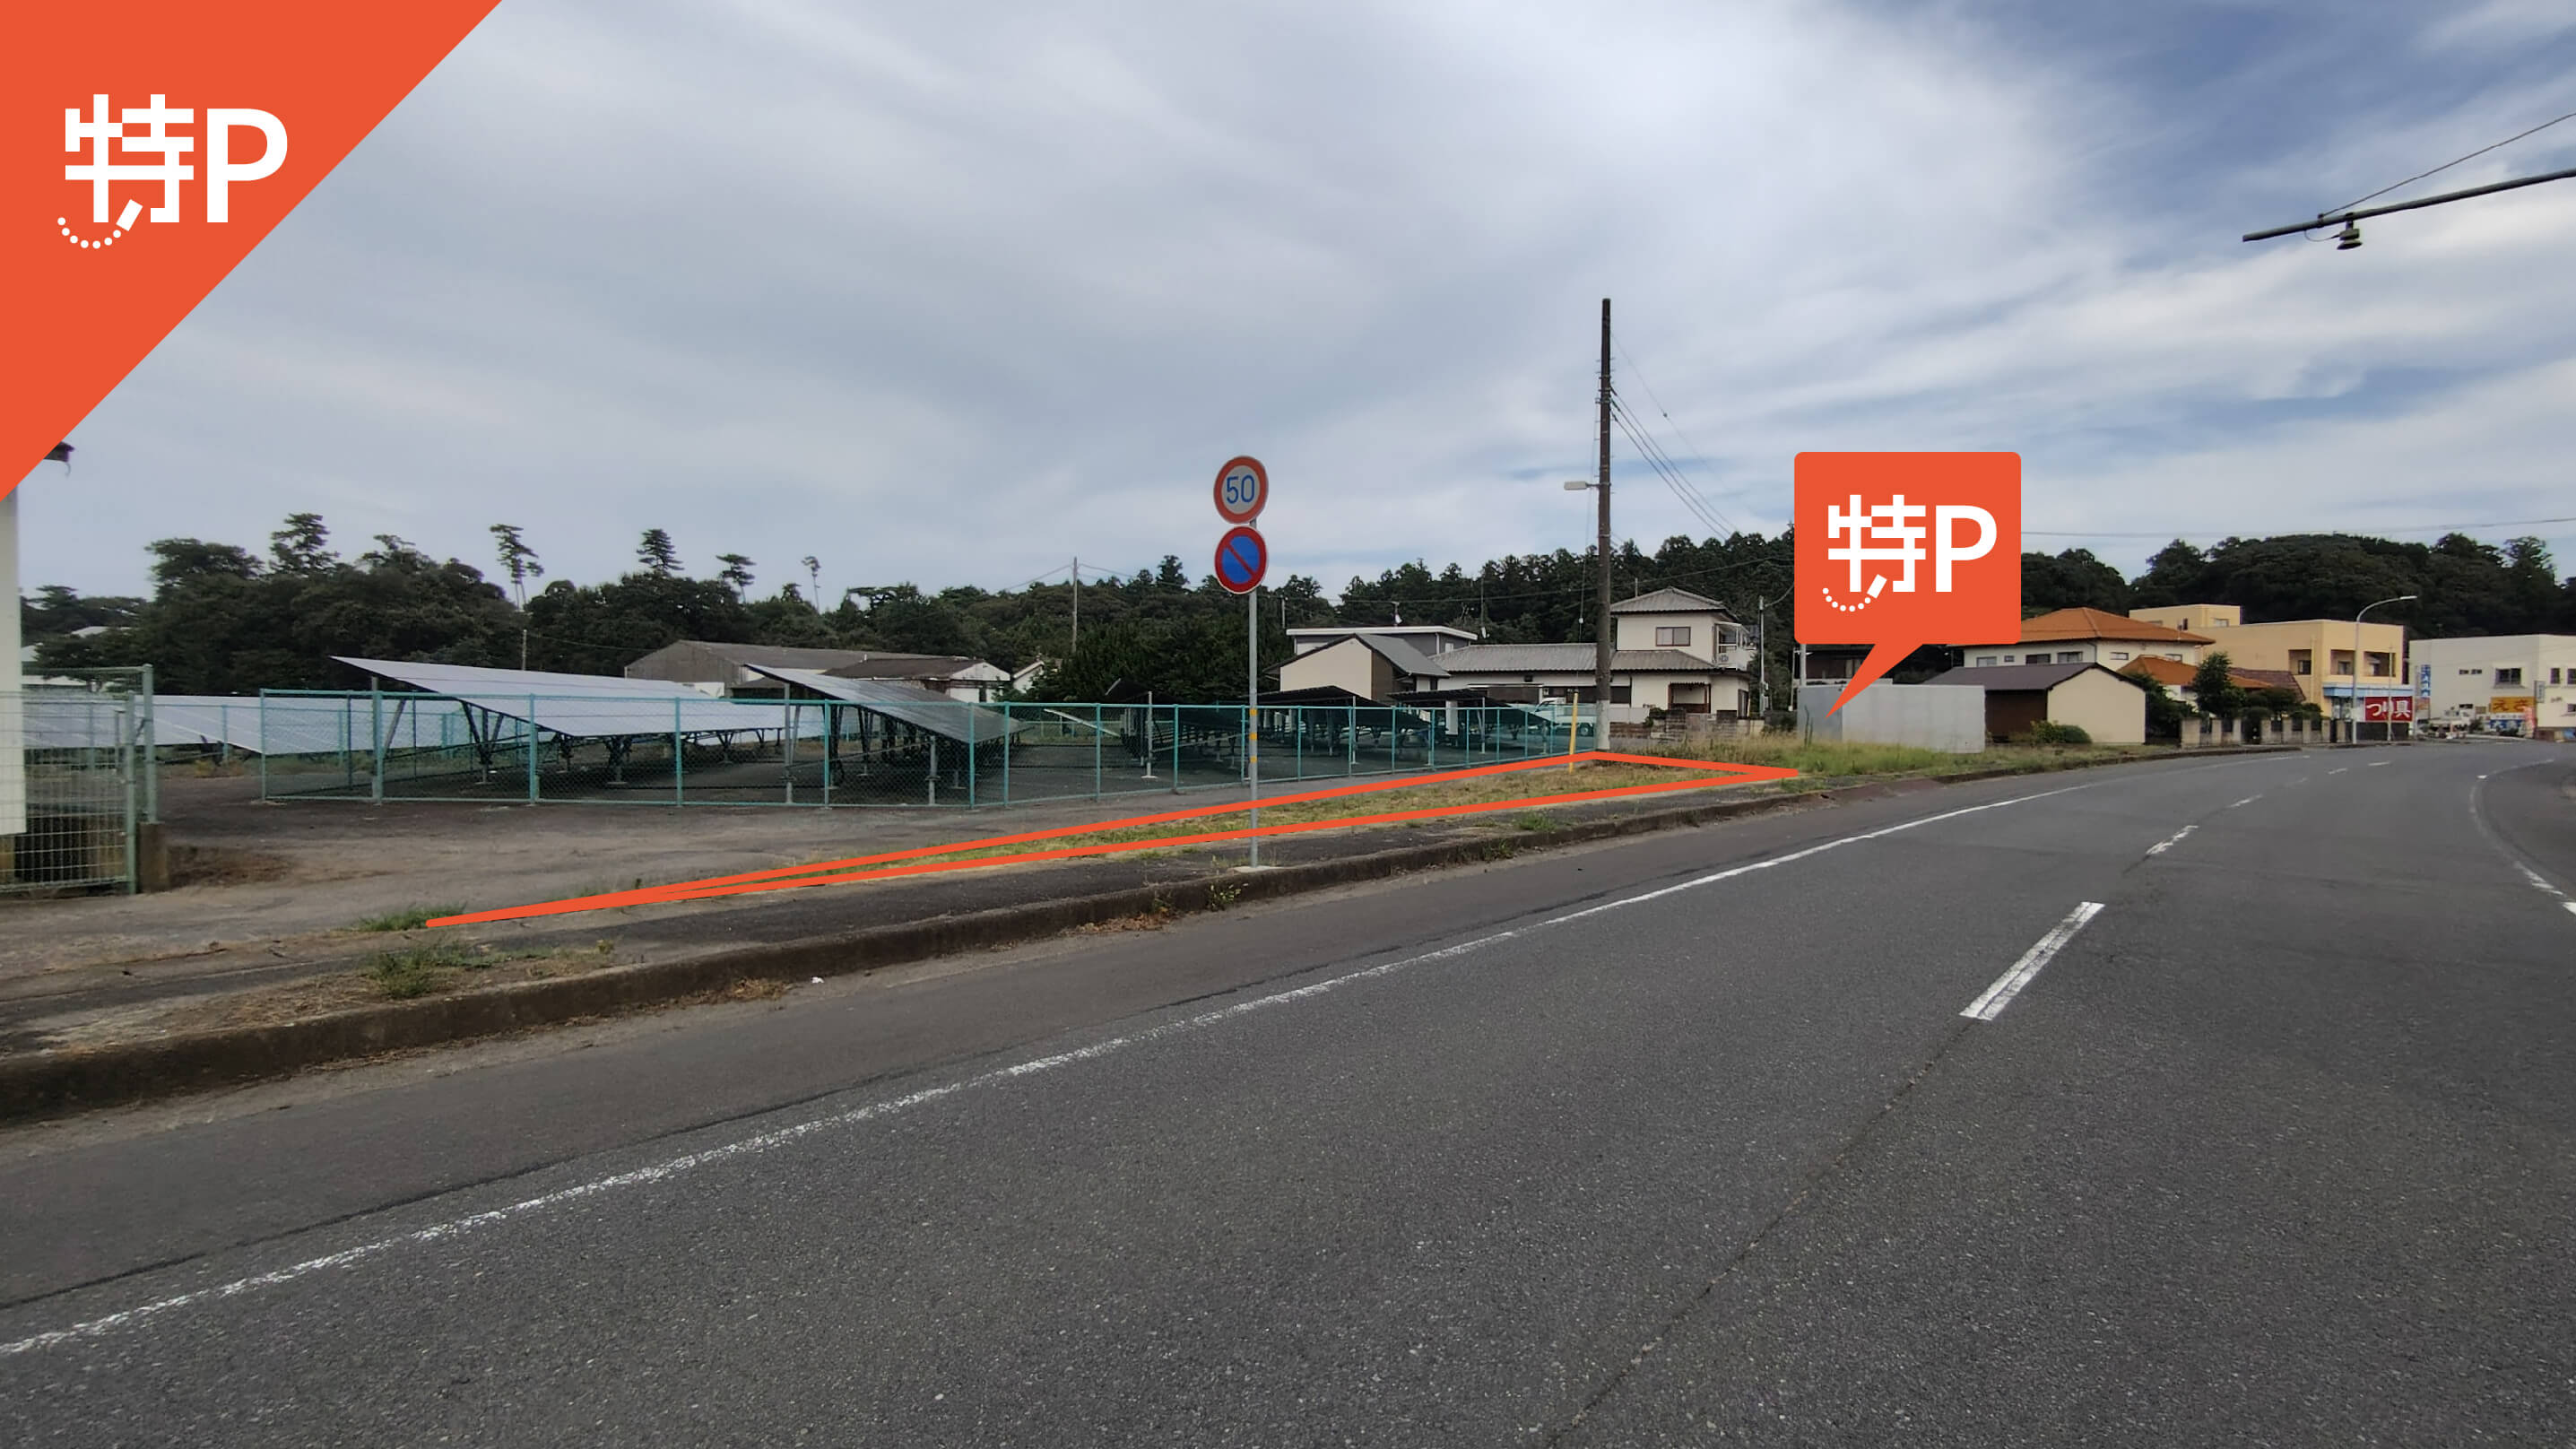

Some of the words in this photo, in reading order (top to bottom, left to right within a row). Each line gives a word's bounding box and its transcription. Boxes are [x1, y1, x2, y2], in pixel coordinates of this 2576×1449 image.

[1226, 474, 1255, 504] 50
[2366, 700, 2411, 718] つり具
[2493, 699, 2528, 711] えさ
